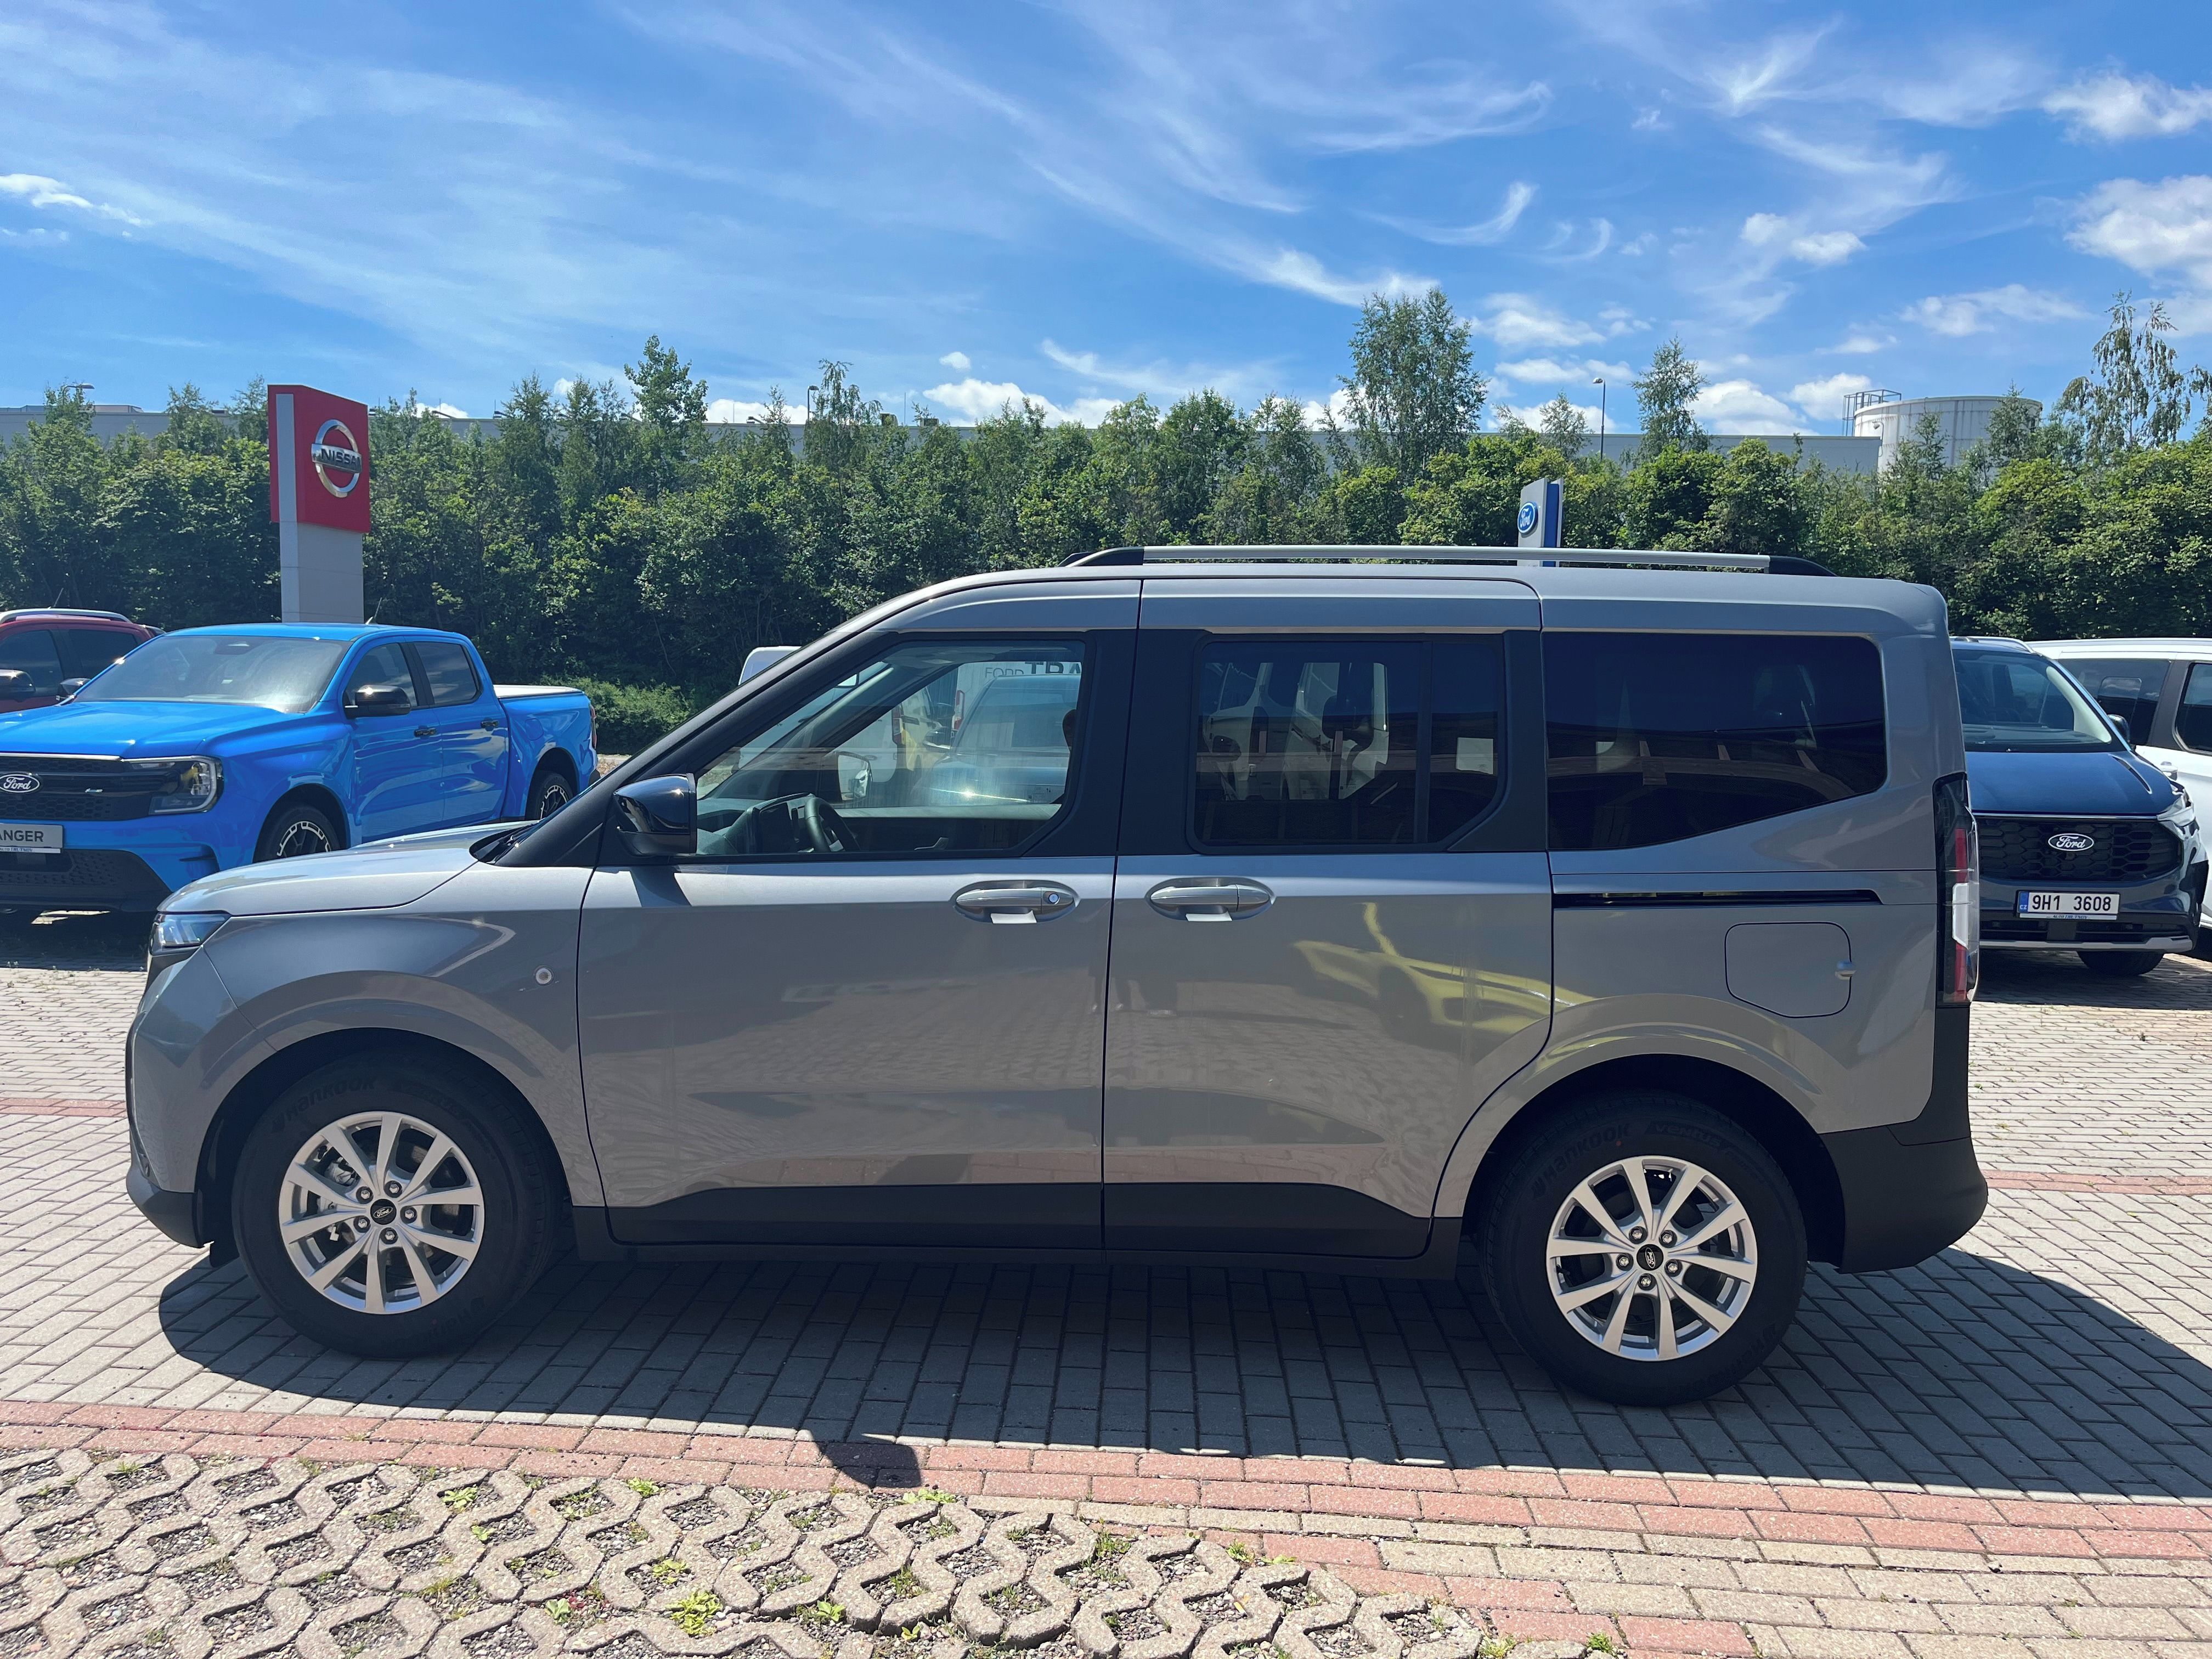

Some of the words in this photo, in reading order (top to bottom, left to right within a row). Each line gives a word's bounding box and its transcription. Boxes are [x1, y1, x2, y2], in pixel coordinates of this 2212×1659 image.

[3, 776, 31, 790] Ford
[2056, 835, 2086, 848] Ford
[2032, 895, 2060, 910] 9H1
[2073, 896, 2111, 911] 3608
